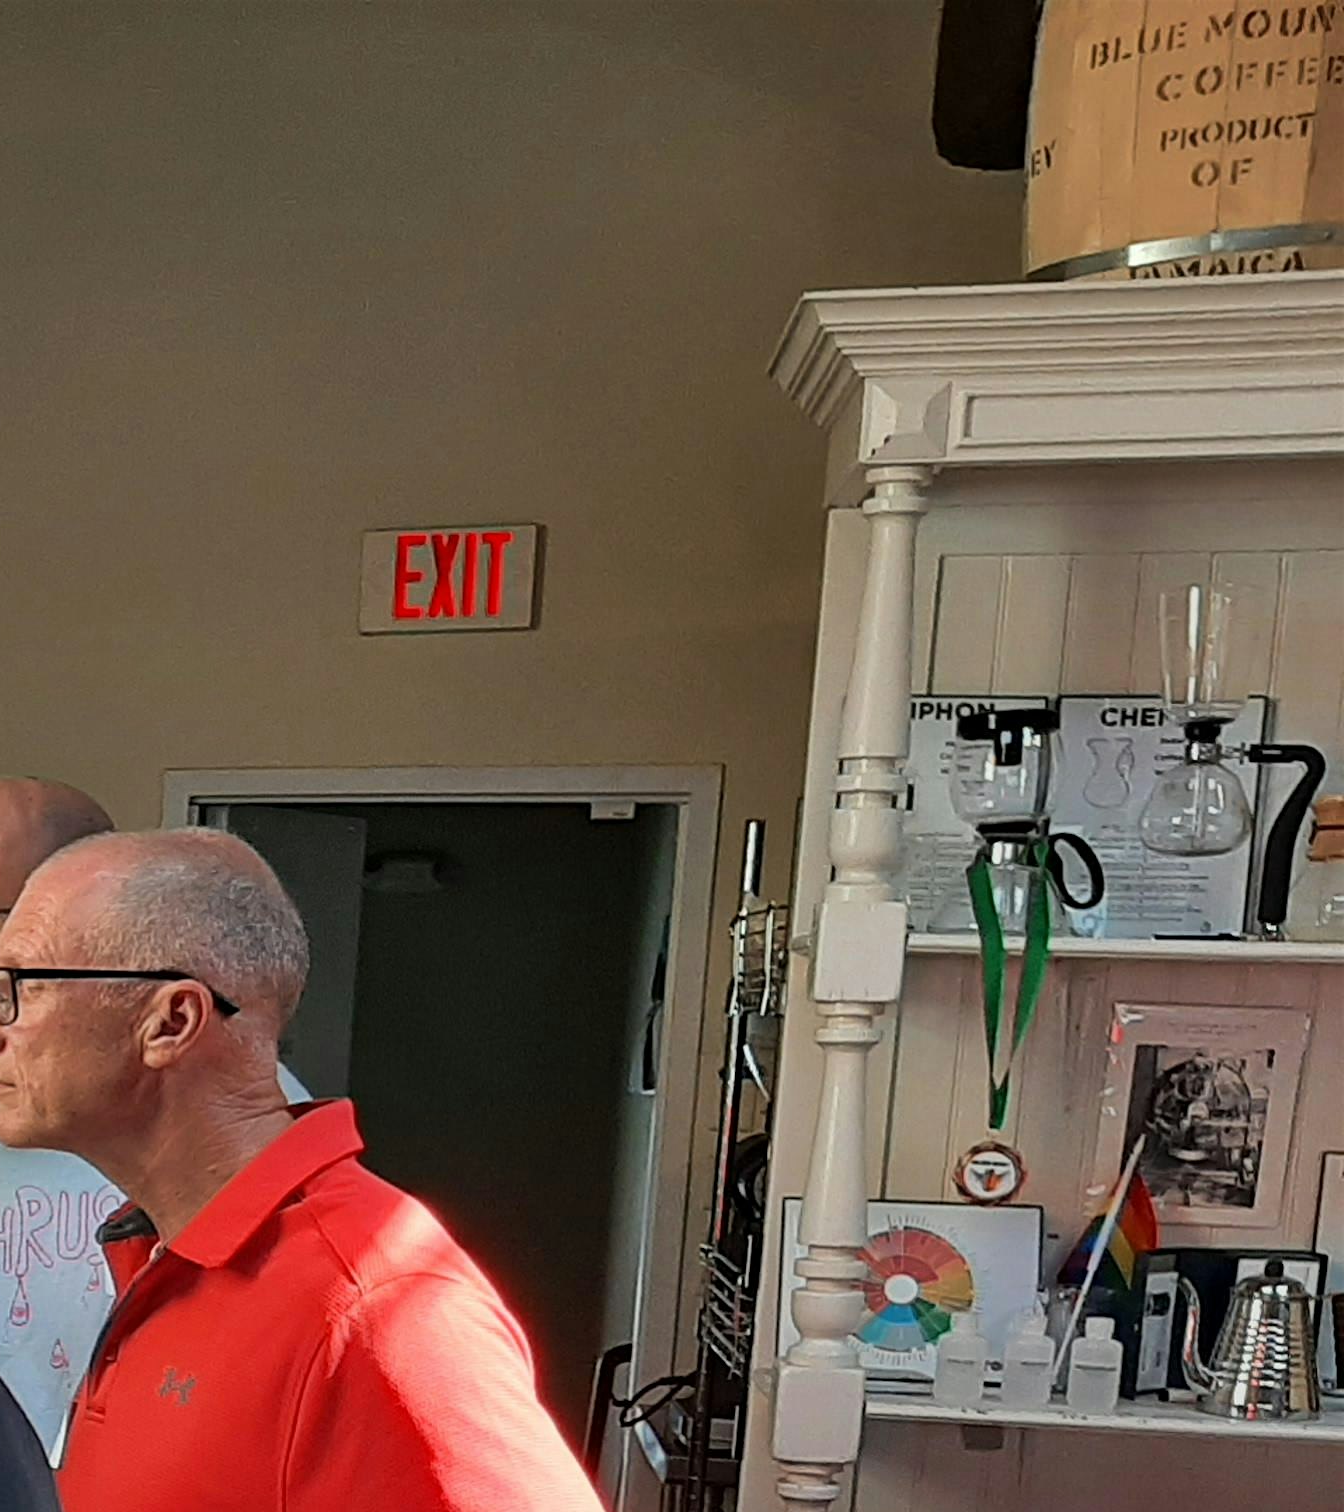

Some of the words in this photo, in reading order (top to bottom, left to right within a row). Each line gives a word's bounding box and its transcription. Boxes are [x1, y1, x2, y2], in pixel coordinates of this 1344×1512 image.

[1090, 21, 1188, 70] BLUE
[1204, 3, 1344, 43] MOUN
[1156, 55, 1344, 102] COFFEE
[1160, 112, 1316, 152] PRODUCT
[1192, 157, 1253, 188] OF
[393, 530, 515, 620] EXIT
[1100, 708, 1167, 728] CHE
